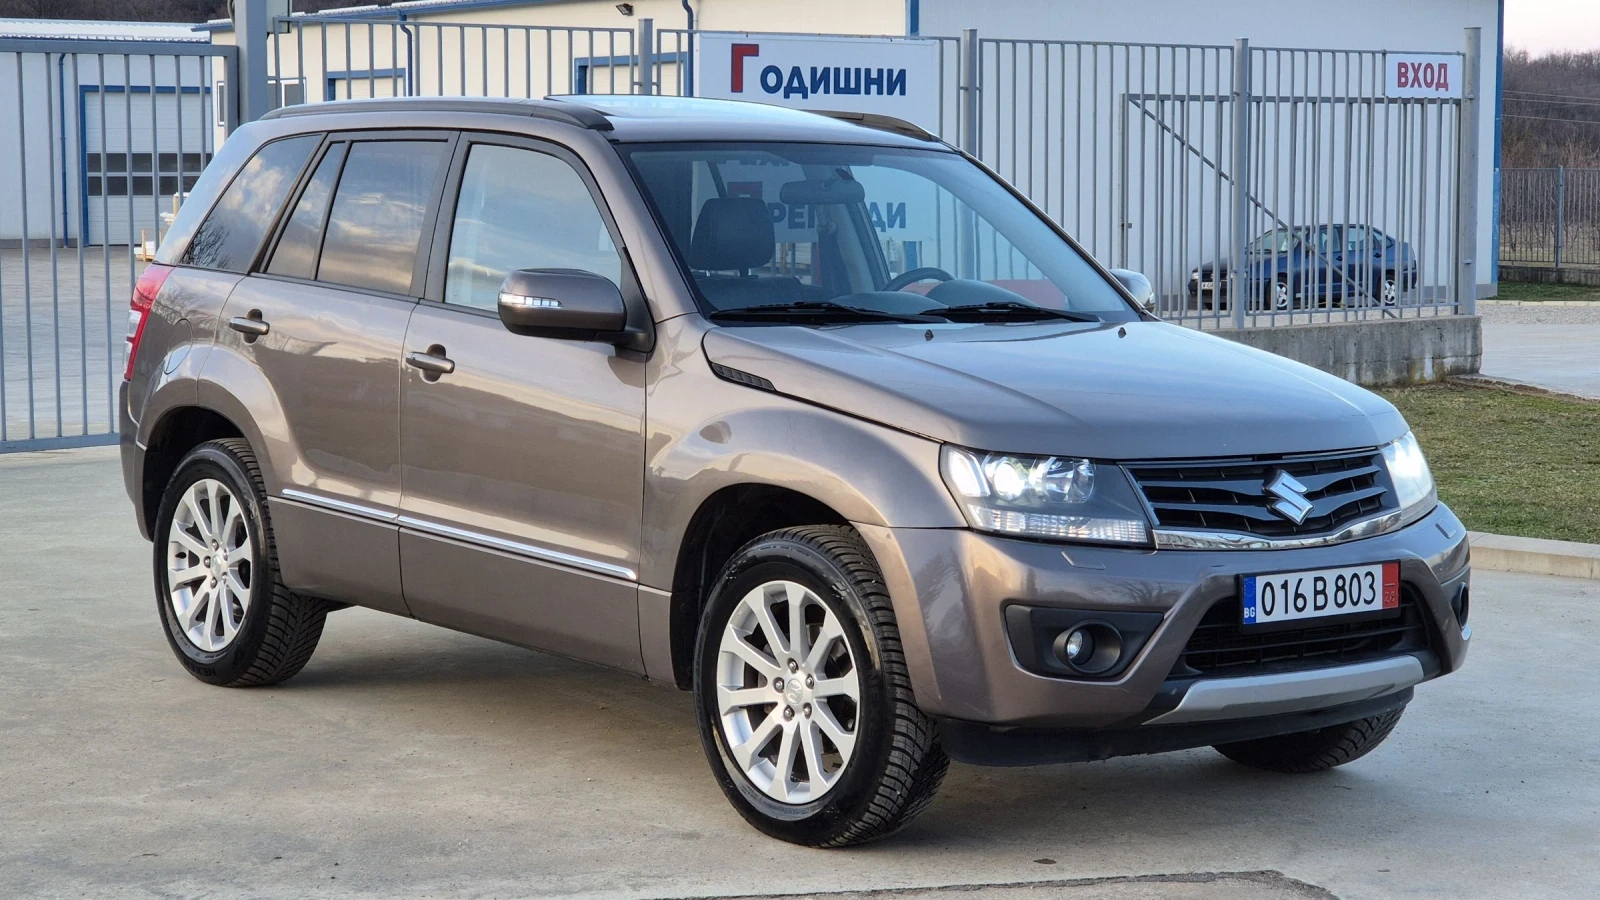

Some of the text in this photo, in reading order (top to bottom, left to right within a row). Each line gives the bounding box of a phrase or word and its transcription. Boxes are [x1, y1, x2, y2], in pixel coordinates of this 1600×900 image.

[731, 43, 906, 99] ГОДИШНИ
[1397, 62, 1449, 92] ВХОД
[1244, 606, 1256, 618] BG
